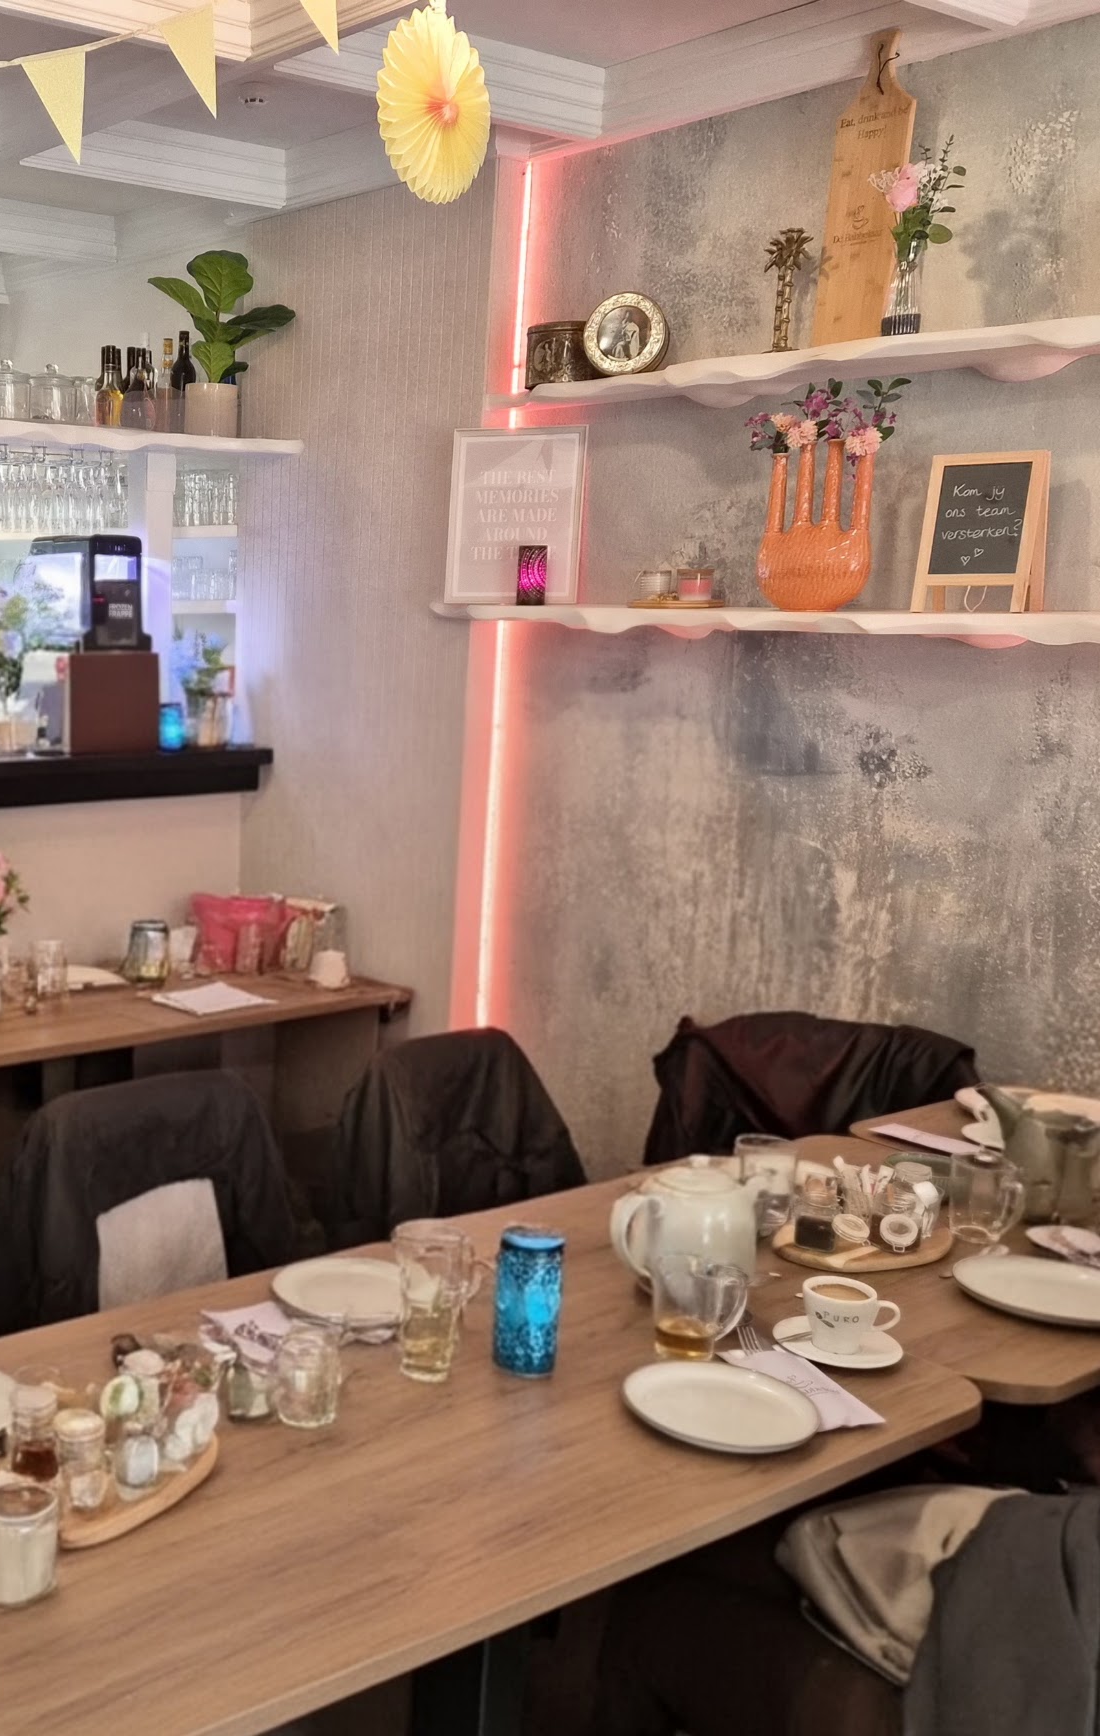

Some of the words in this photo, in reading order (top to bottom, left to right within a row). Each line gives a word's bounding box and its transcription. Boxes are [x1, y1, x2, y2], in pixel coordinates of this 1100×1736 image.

[840, 119, 856, 129] Eat,
[858, 112, 879, 125] drink
[857, 124, 887, 140] Happy!
[481, 471, 513, 486] THE
[516, 469, 557, 485] BEST
[475, 488, 559, 505] MEMORIES
[953, 483, 983, 497] Kom
[477, 508, 508, 523] ARE
[512, 507, 557, 523] MADE
[945, 508, 966, 518] ons
[976, 505, 1017, 517] team
[484, 526, 548, 542] AROUND
[941, 518, 1023, 540] versterken?
[471, 546, 506, 561] THE
[108, 603, 133, 611] FROZEN
[822, 1311, 860, 1324] PURO
